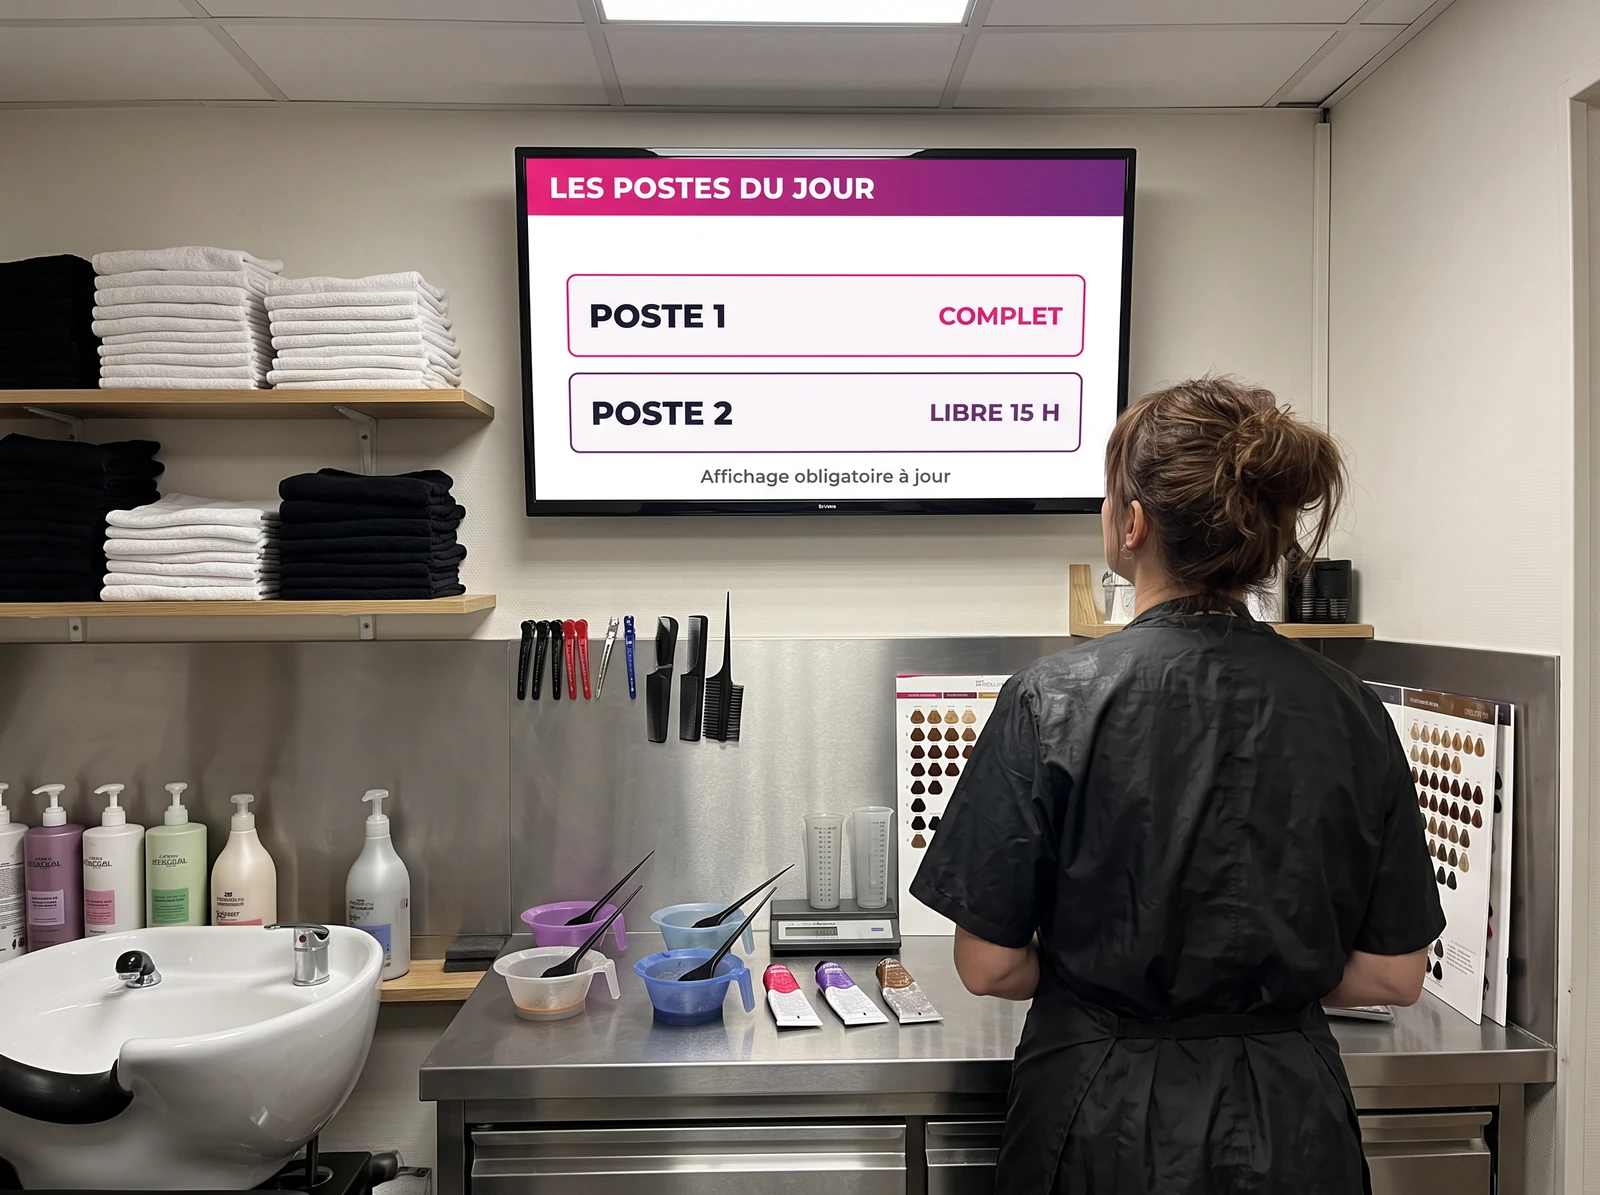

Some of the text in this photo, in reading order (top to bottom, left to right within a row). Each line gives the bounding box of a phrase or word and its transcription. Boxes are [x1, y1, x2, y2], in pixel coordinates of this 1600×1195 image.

[550, 176, 875, 200] LES POSTES DU JOUR
[590, 303, 725, 329] POSTE 1
[938, 306, 1064, 326] COMPLET
[592, 400, 733, 426] POSTE 2
[930, 403, 1060, 422] LIBRE 15 H
[700, 467, 951, 488] Affichage obligatoire à jour
